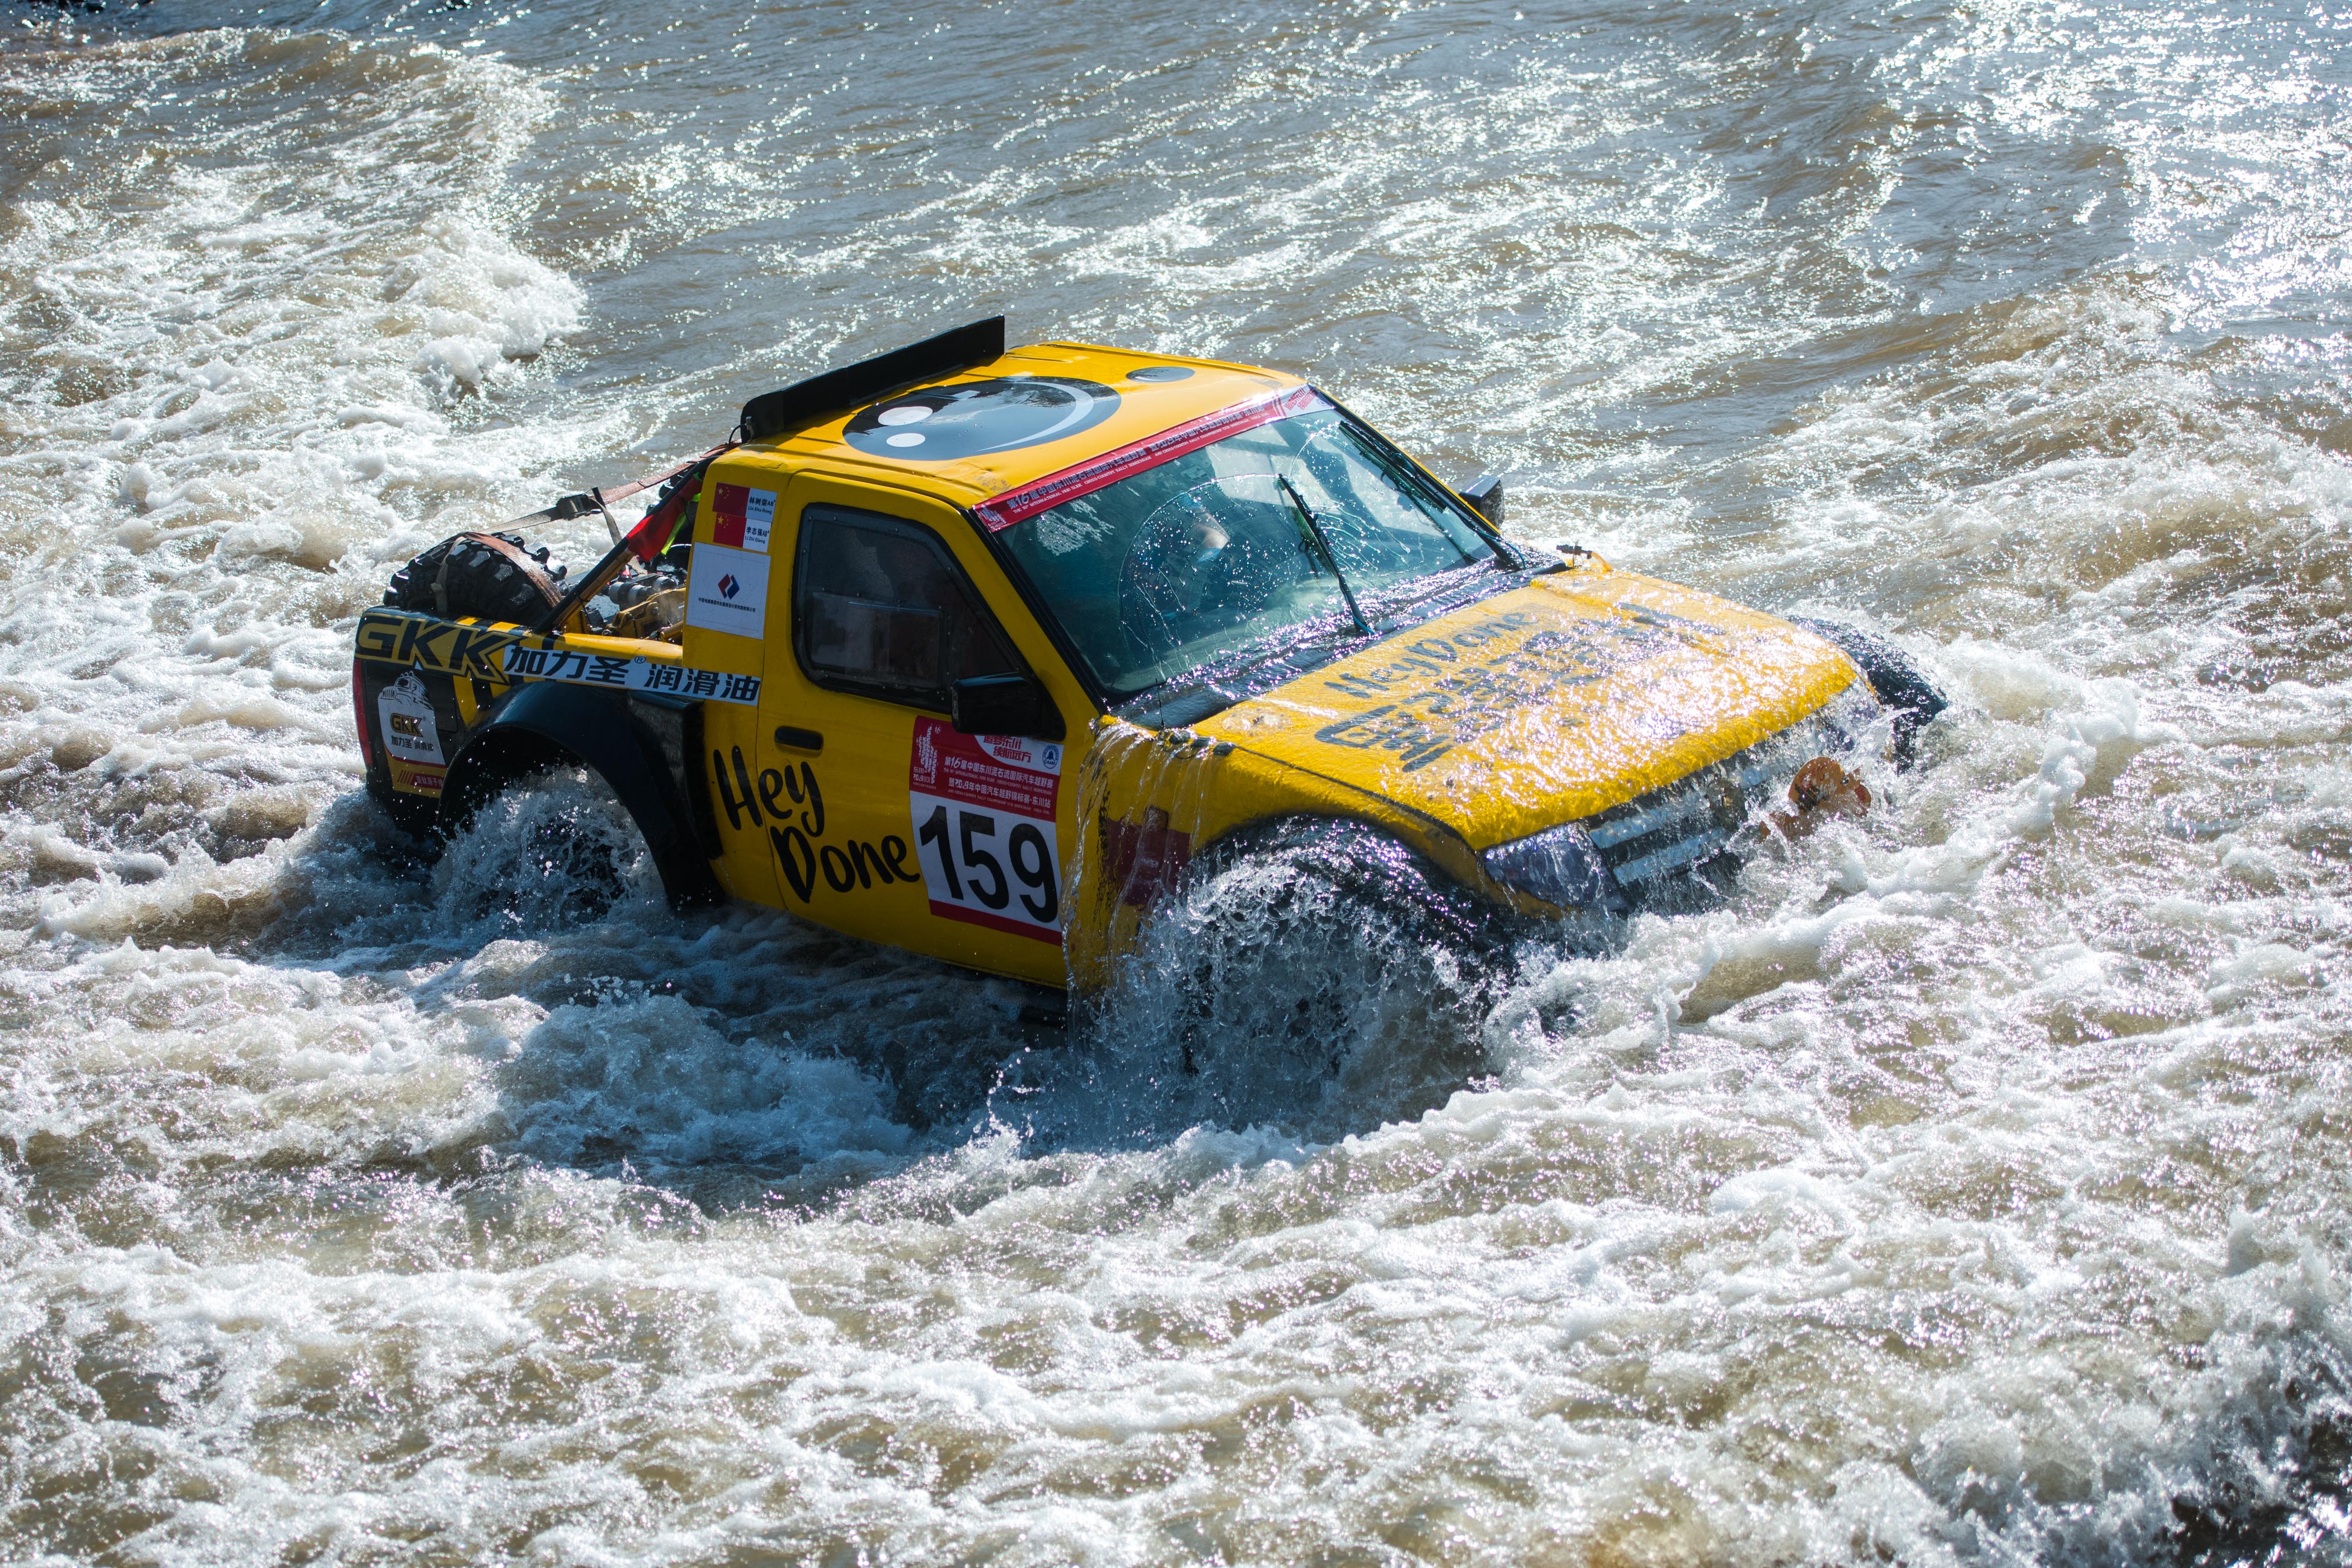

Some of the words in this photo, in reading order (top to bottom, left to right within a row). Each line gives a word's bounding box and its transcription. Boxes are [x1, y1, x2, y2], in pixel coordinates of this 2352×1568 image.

[355, 613, 526, 686] GKK
[390, 713, 423, 737] GKK
[714, 745, 825, 837] Hey
[944, 755, 1053, 788] 第16届中国东川泥石流国际汽车越野赛
[770, 825, 920, 903] Done
[920, 805, 1059, 922] 159
